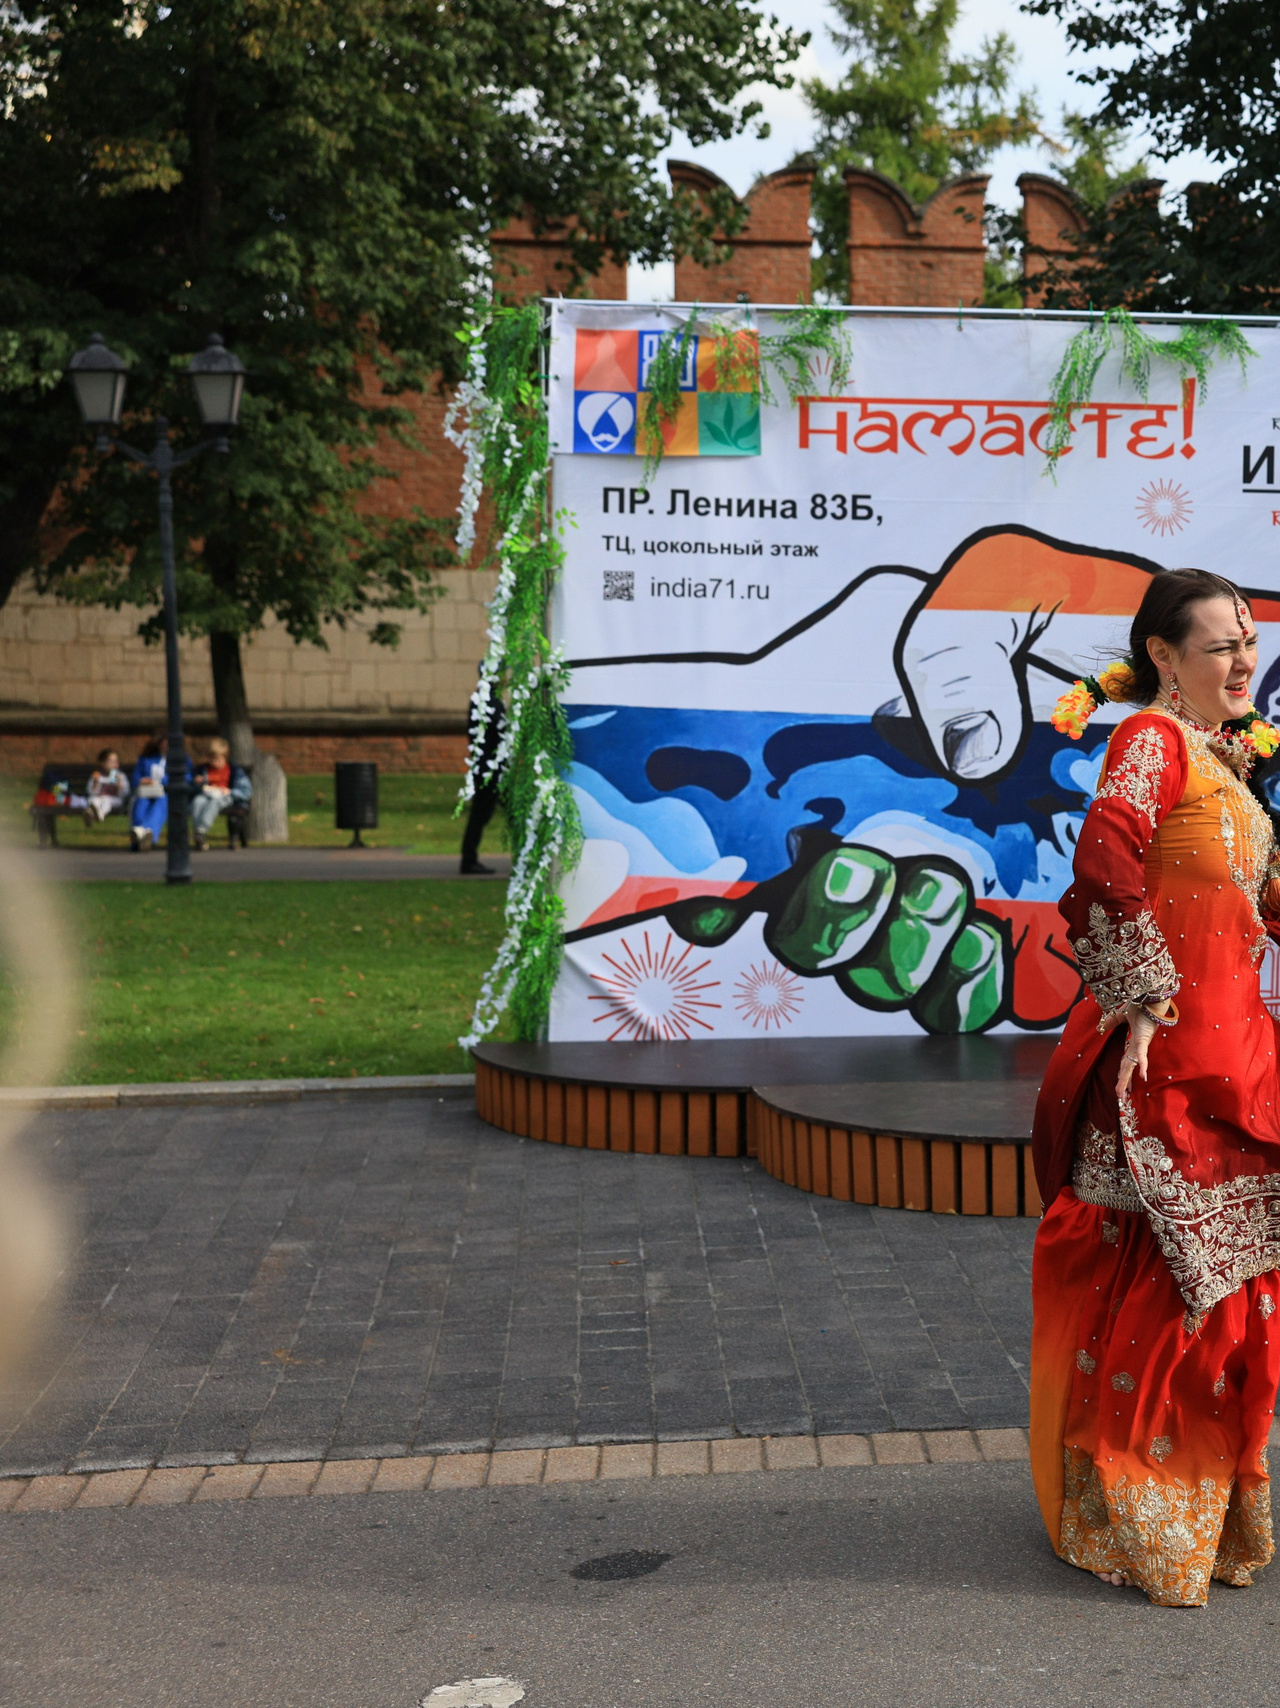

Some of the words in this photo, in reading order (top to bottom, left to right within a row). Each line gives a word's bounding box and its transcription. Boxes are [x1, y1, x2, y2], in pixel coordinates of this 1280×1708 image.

[602, 486, 654, 515] ПР.
[666, 488, 798, 519] Ленина
[810, 493, 883, 526] 83Б,
[602, 535, 636, 554] ТЦ,
[643, 539, 763, 556] цокольный
[770, 542, 820, 557] этаж
[650, 576, 771, 600] india71.ru
